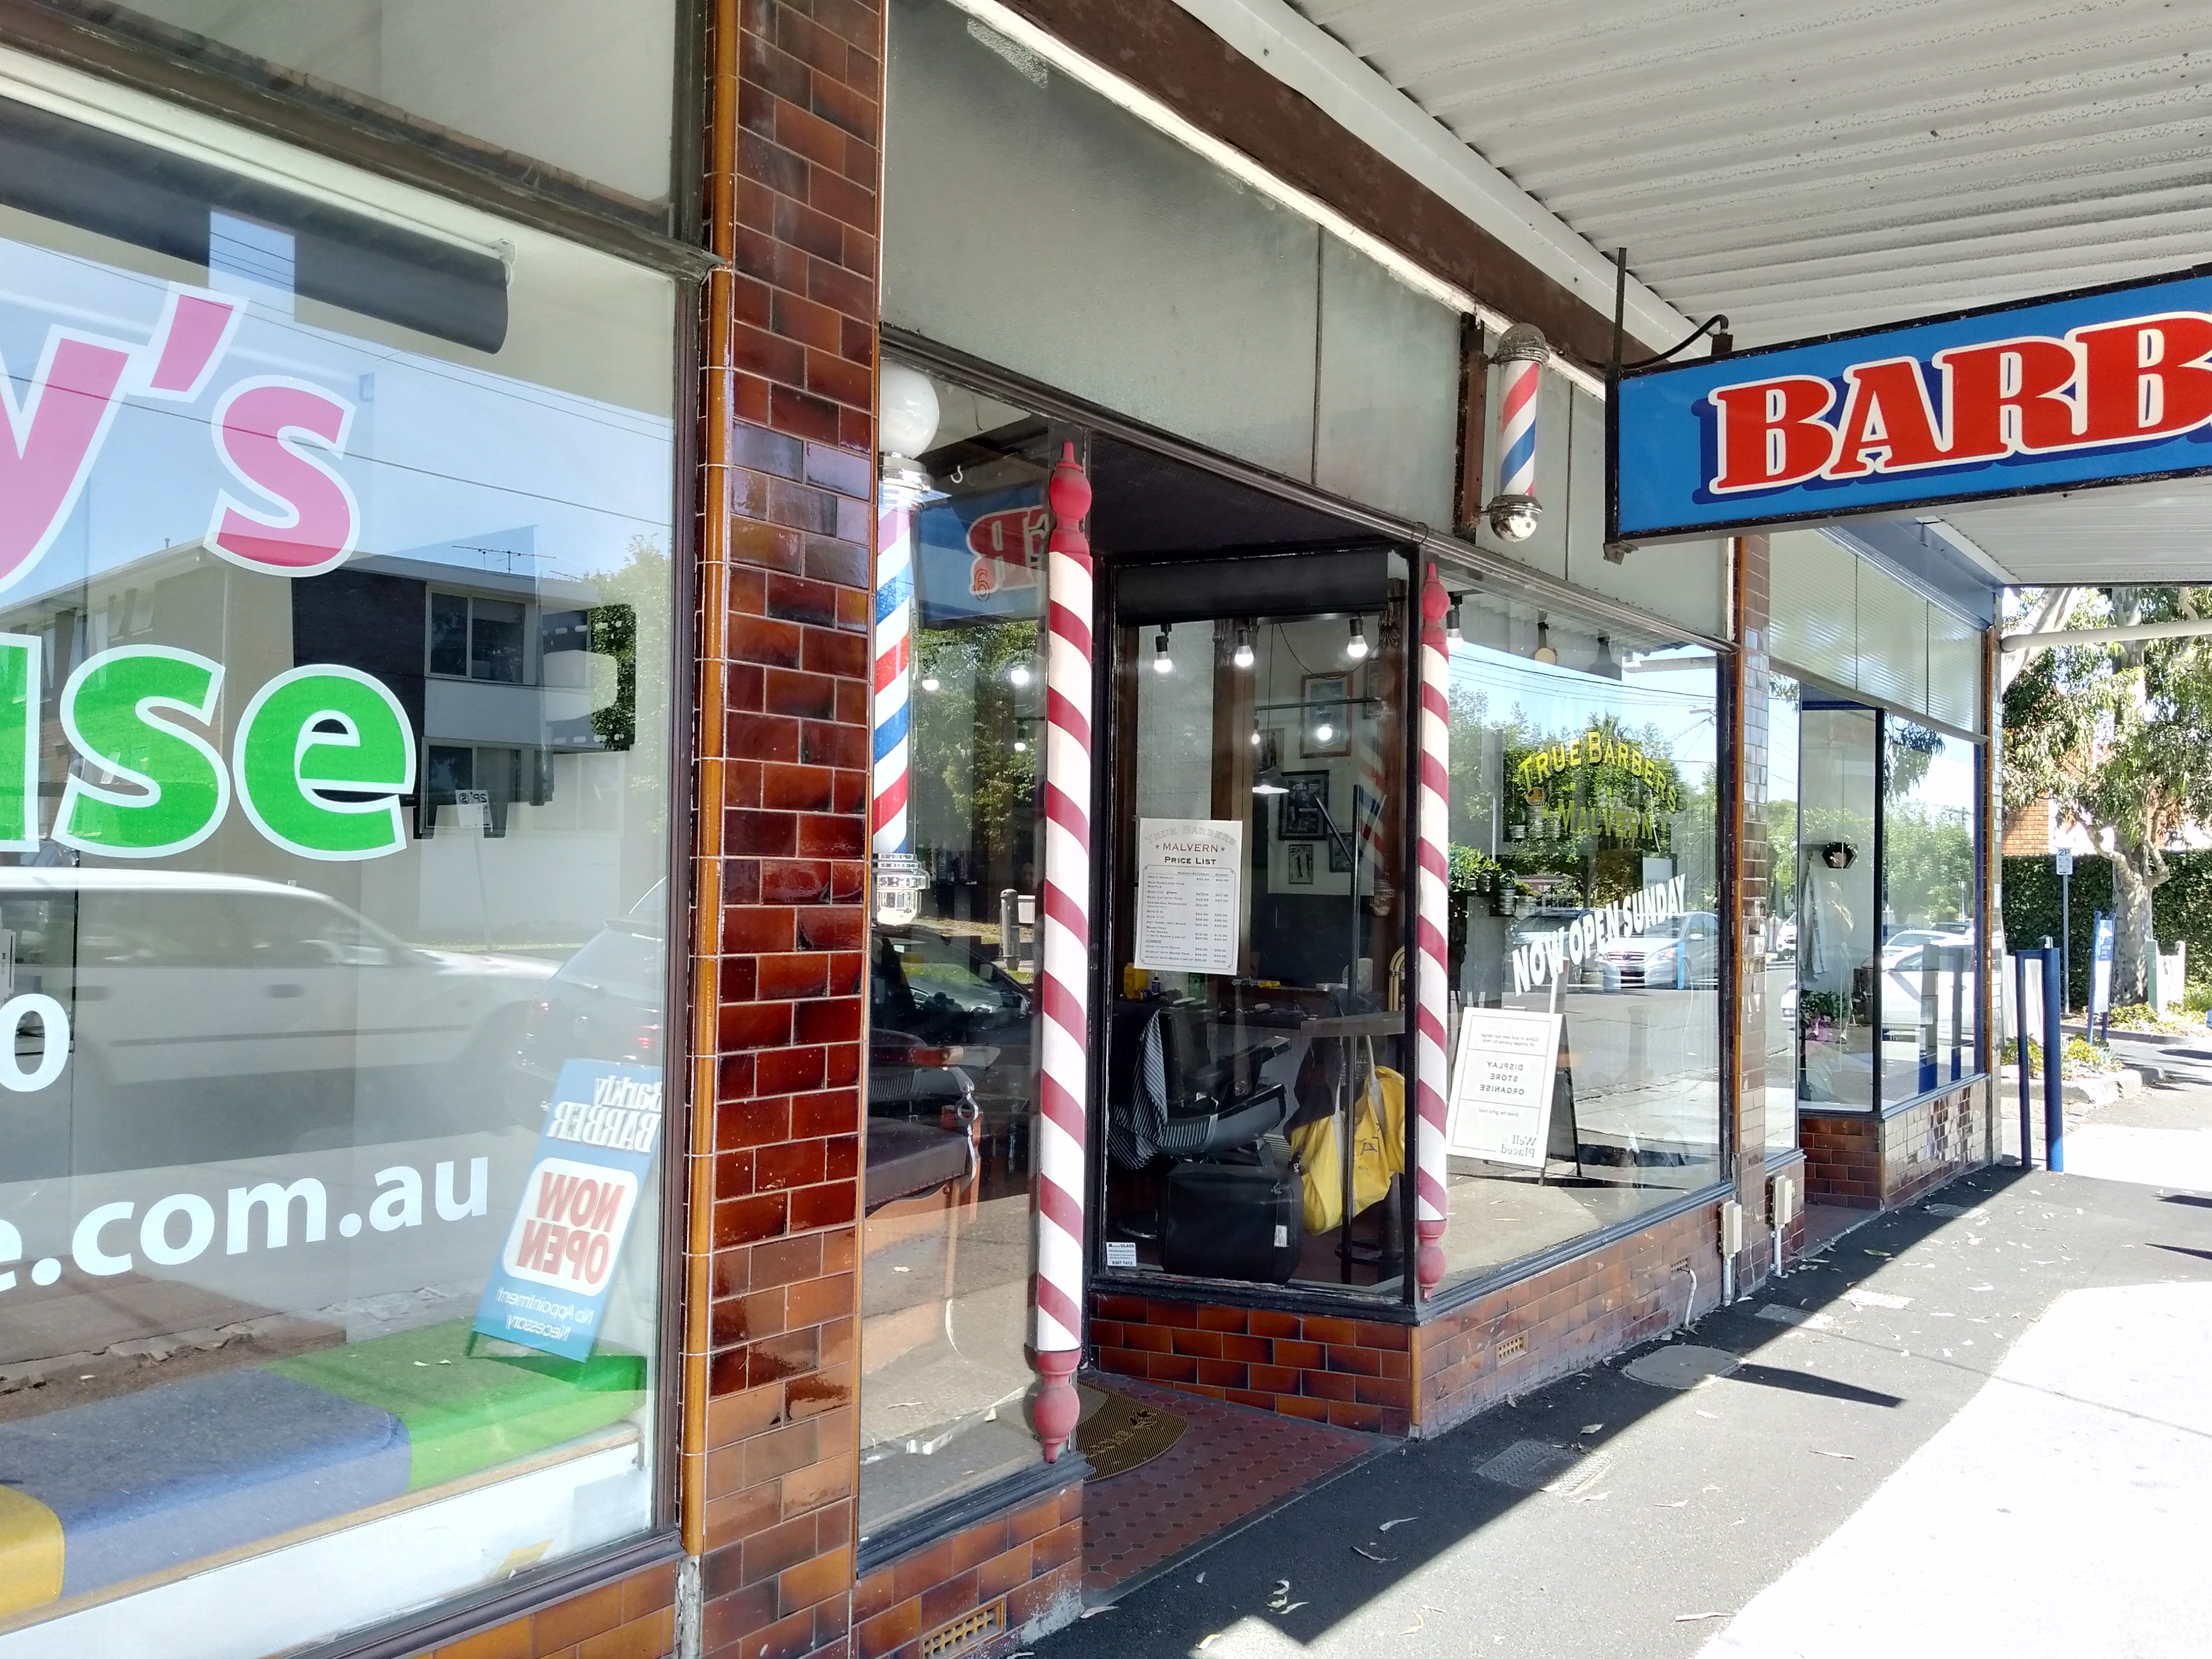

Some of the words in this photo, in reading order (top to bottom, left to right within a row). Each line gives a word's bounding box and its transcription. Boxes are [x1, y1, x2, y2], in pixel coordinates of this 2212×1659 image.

[1518, 738, 1582, 793] TRUE
[1588, 732, 1678, 814] BARBERS
[1145, 828, 1177, 844] TRUE
[1183, 826, 1236, 845] BARBERS
[1558, 799, 1653, 840] MALVERN
[1163, 843, 1219, 852] MALVERN
[1512, 926, 1564, 998] NOW
[1569, 901, 1620, 966] OPEN
[1622, 874, 1686, 938] SUNDAY
